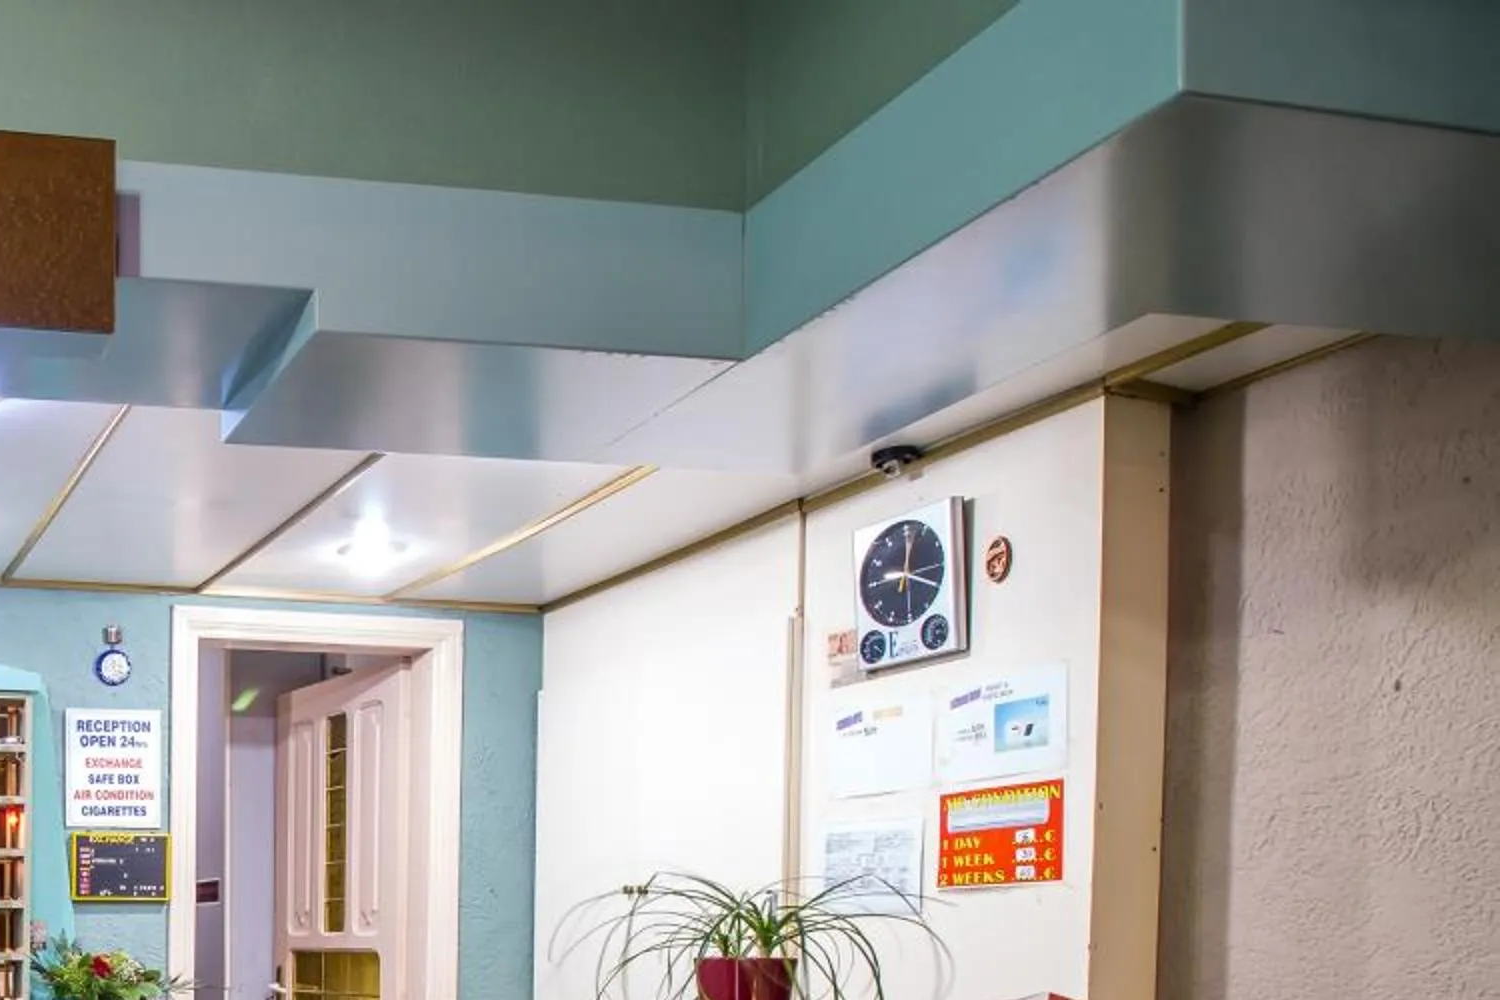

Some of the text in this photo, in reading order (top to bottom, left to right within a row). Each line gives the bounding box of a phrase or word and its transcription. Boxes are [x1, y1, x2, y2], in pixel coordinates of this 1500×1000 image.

[76, 719, 151, 733] RECEPTION
[79, 734, 117, 748] OPEN
[84, 756, 143, 769] EXCHANGE
[87, 772, 140, 785] SAFE BOX
[73, 788, 155, 801] AIR CONDITION
[80, 804, 148, 817] CIGARETTES
[953, 836, 980, 851] DAY
[952, 852, 994, 868] WEEK
[952, 868, 1005, 885] WEEKS
